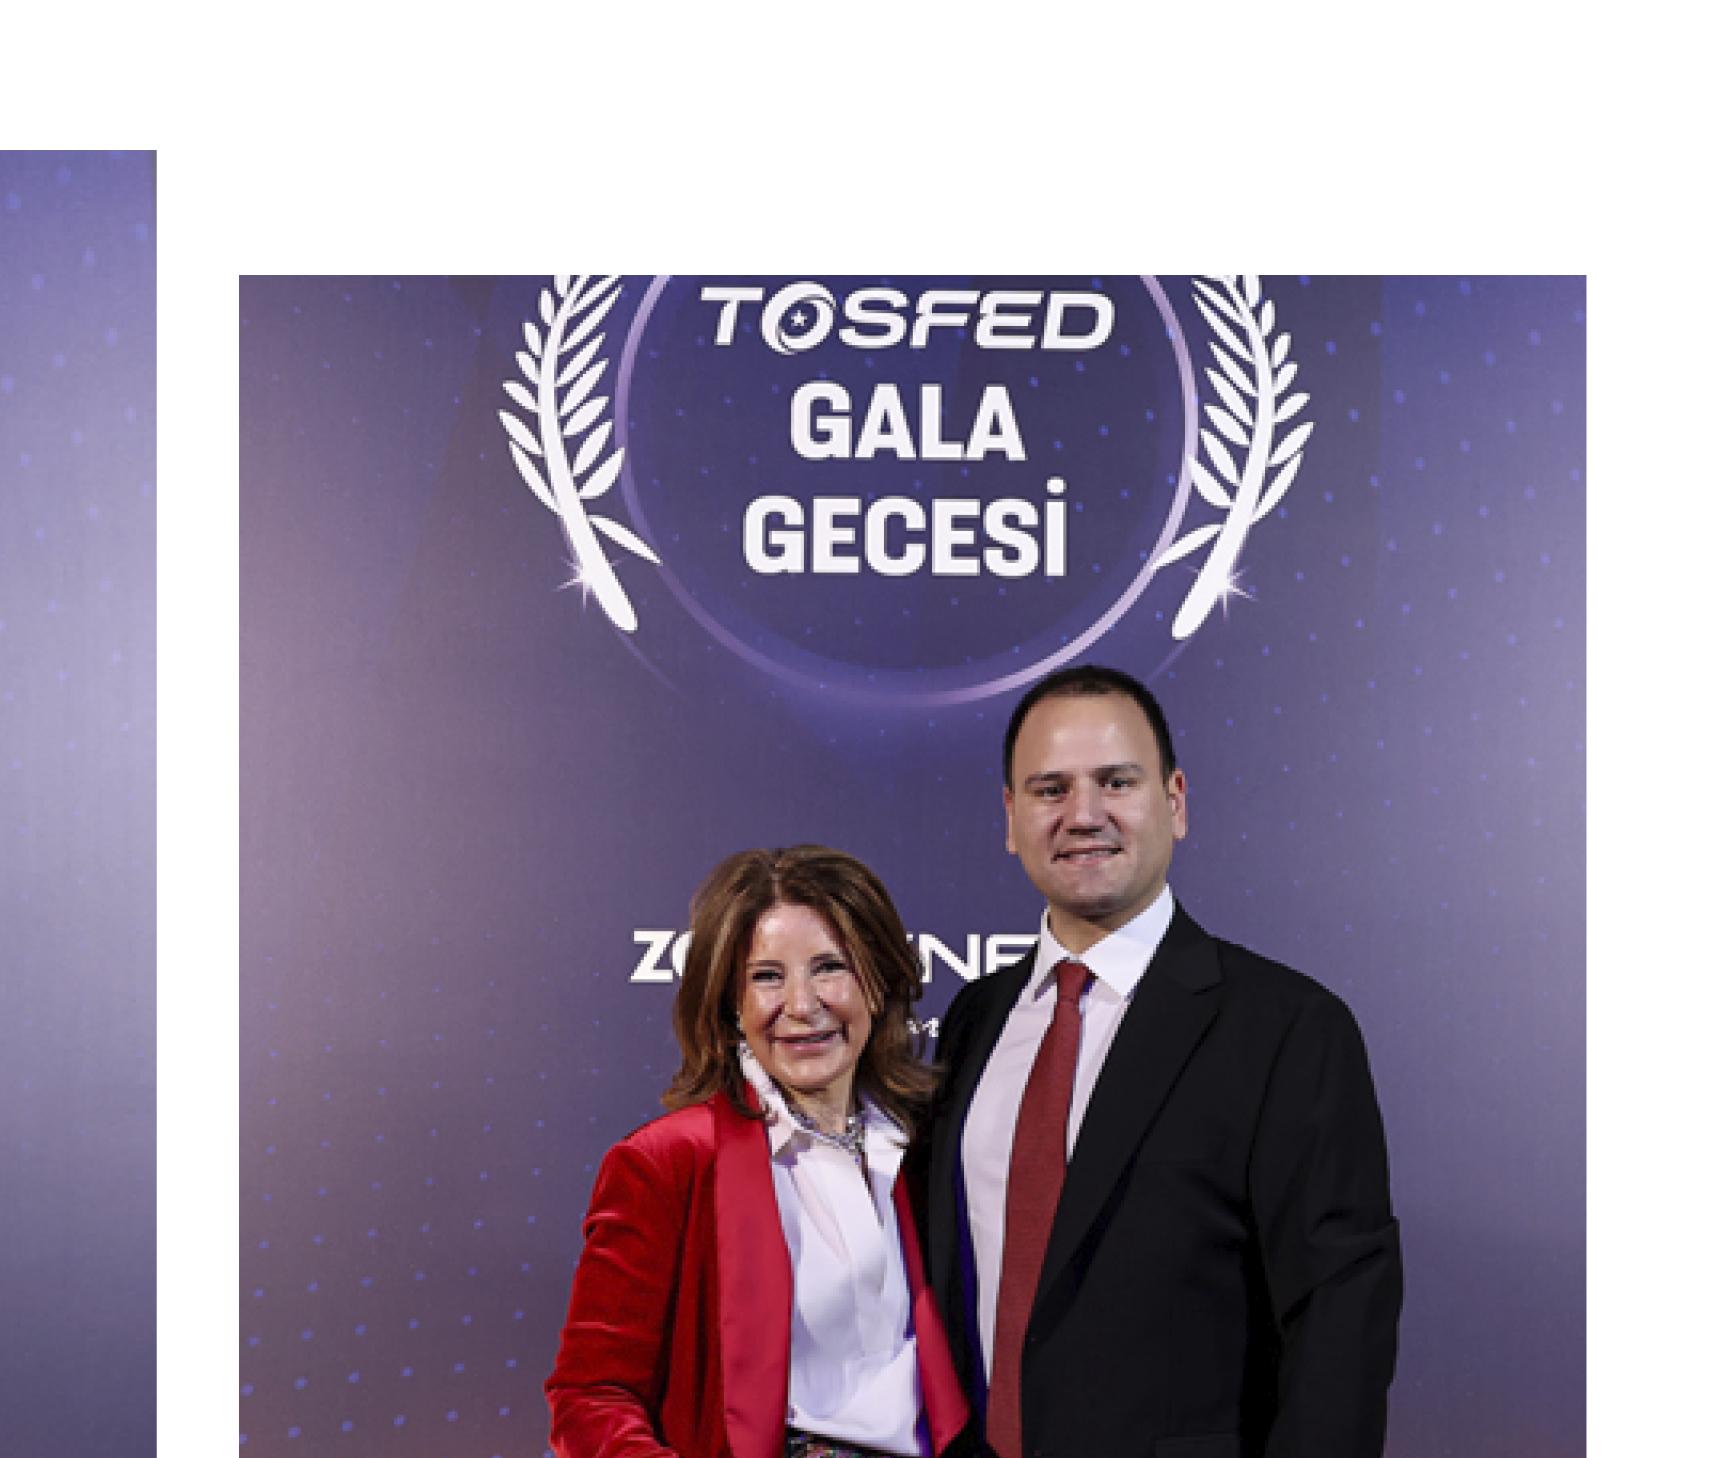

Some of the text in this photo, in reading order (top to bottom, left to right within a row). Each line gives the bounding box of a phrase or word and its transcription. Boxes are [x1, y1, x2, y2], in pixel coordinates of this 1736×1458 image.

[700, 281, 1116, 354] TOSFED
[790, 382, 1026, 461] GALA
[742, 477, 1066, 577] GECESİ
